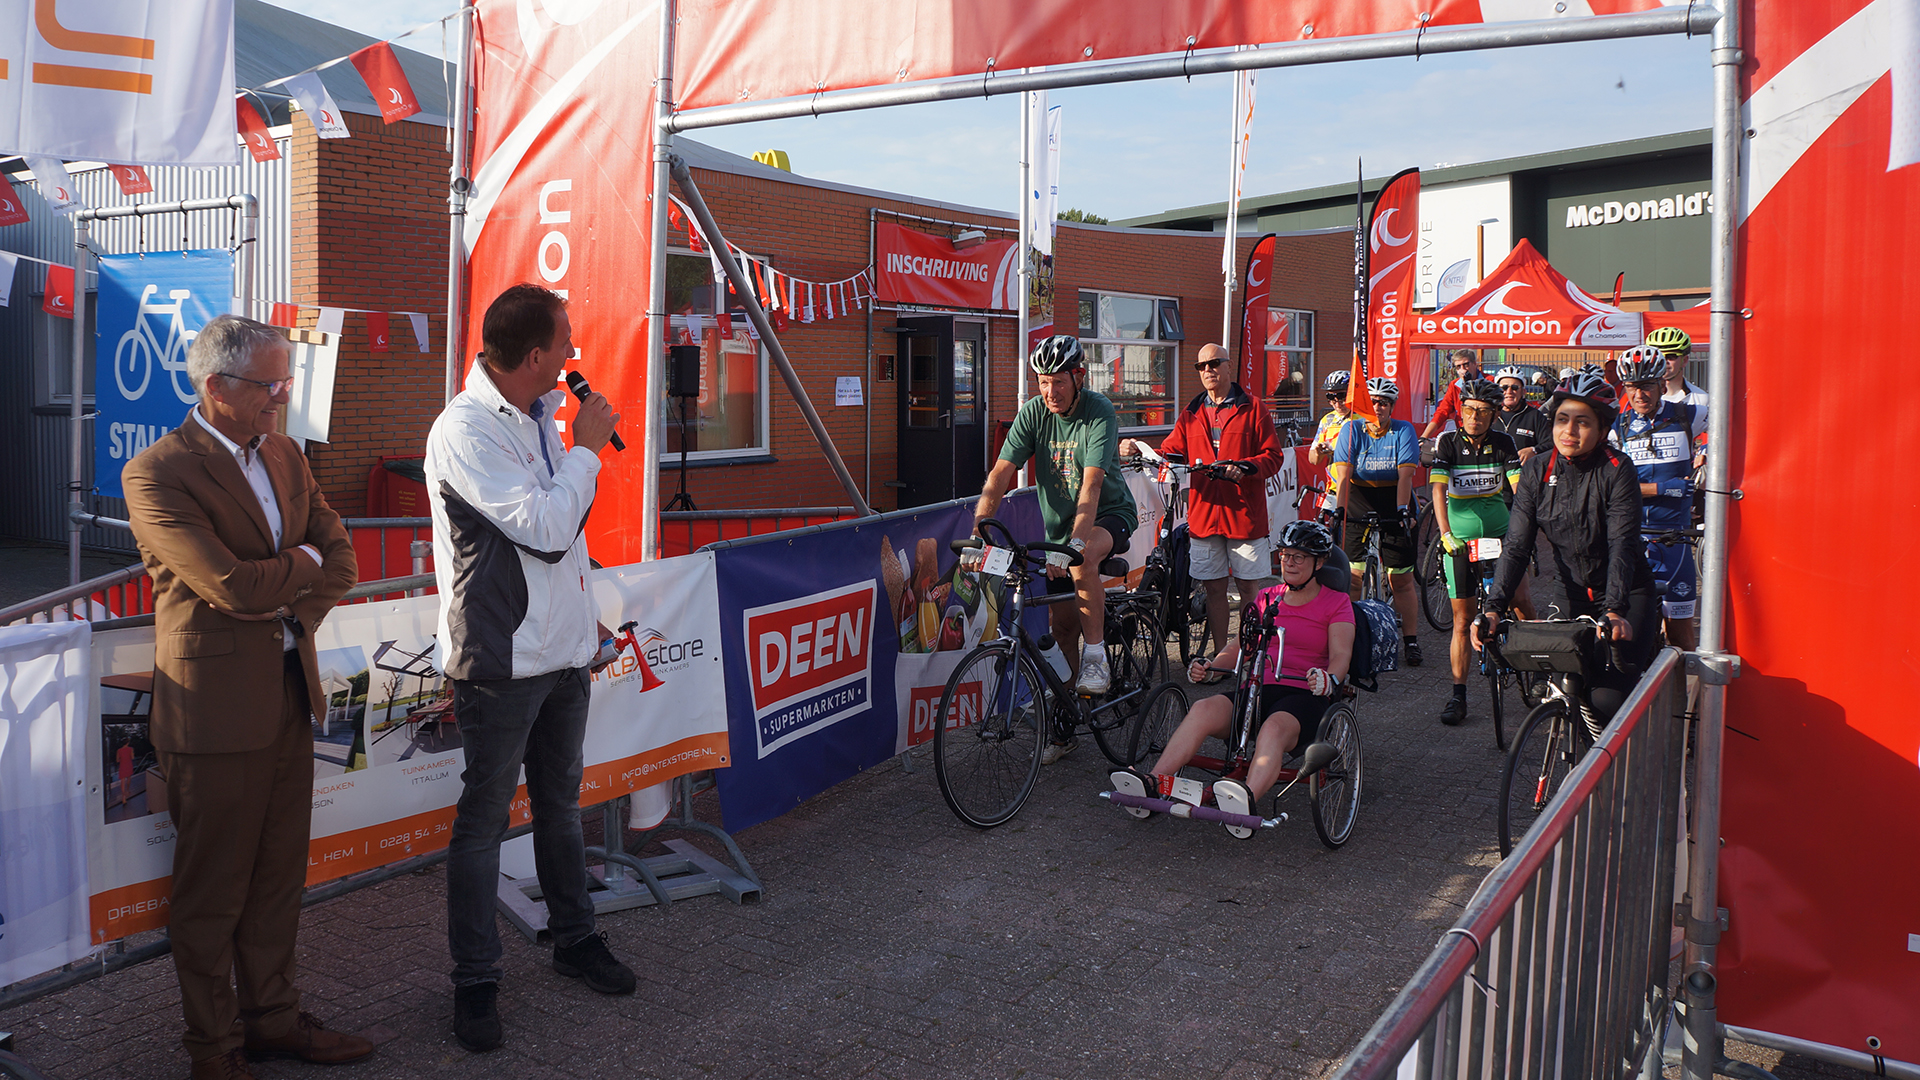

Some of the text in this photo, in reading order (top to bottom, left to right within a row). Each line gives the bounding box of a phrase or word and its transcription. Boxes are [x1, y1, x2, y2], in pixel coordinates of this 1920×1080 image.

[887, 253, 989, 282] INSCHRIJVING
[1422, 220, 1433, 294] DRIVE
[1417, 316, 1561, 338] le Champion
[759, 607, 865, 688] DEEN
[653, 662, 690, 676] UINKAMERS
[769, 687, 855, 735] SUPERMARKTEN
[914, 692, 977, 733] DEEN
[401, 757, 456, 776] TUINKAMERS
[411, 771, 449, 785] ITTALUM
[107, 896, 170, 921] DRIEBA
[323, 847, 354, 862] HEM
[379, 833, 410, 849] 0228
[414, 828, 430, 840] 54
[433, 822, 448, 834] 34
[621, 746, 717, 782] INFO@INTEXSTORE.NL
